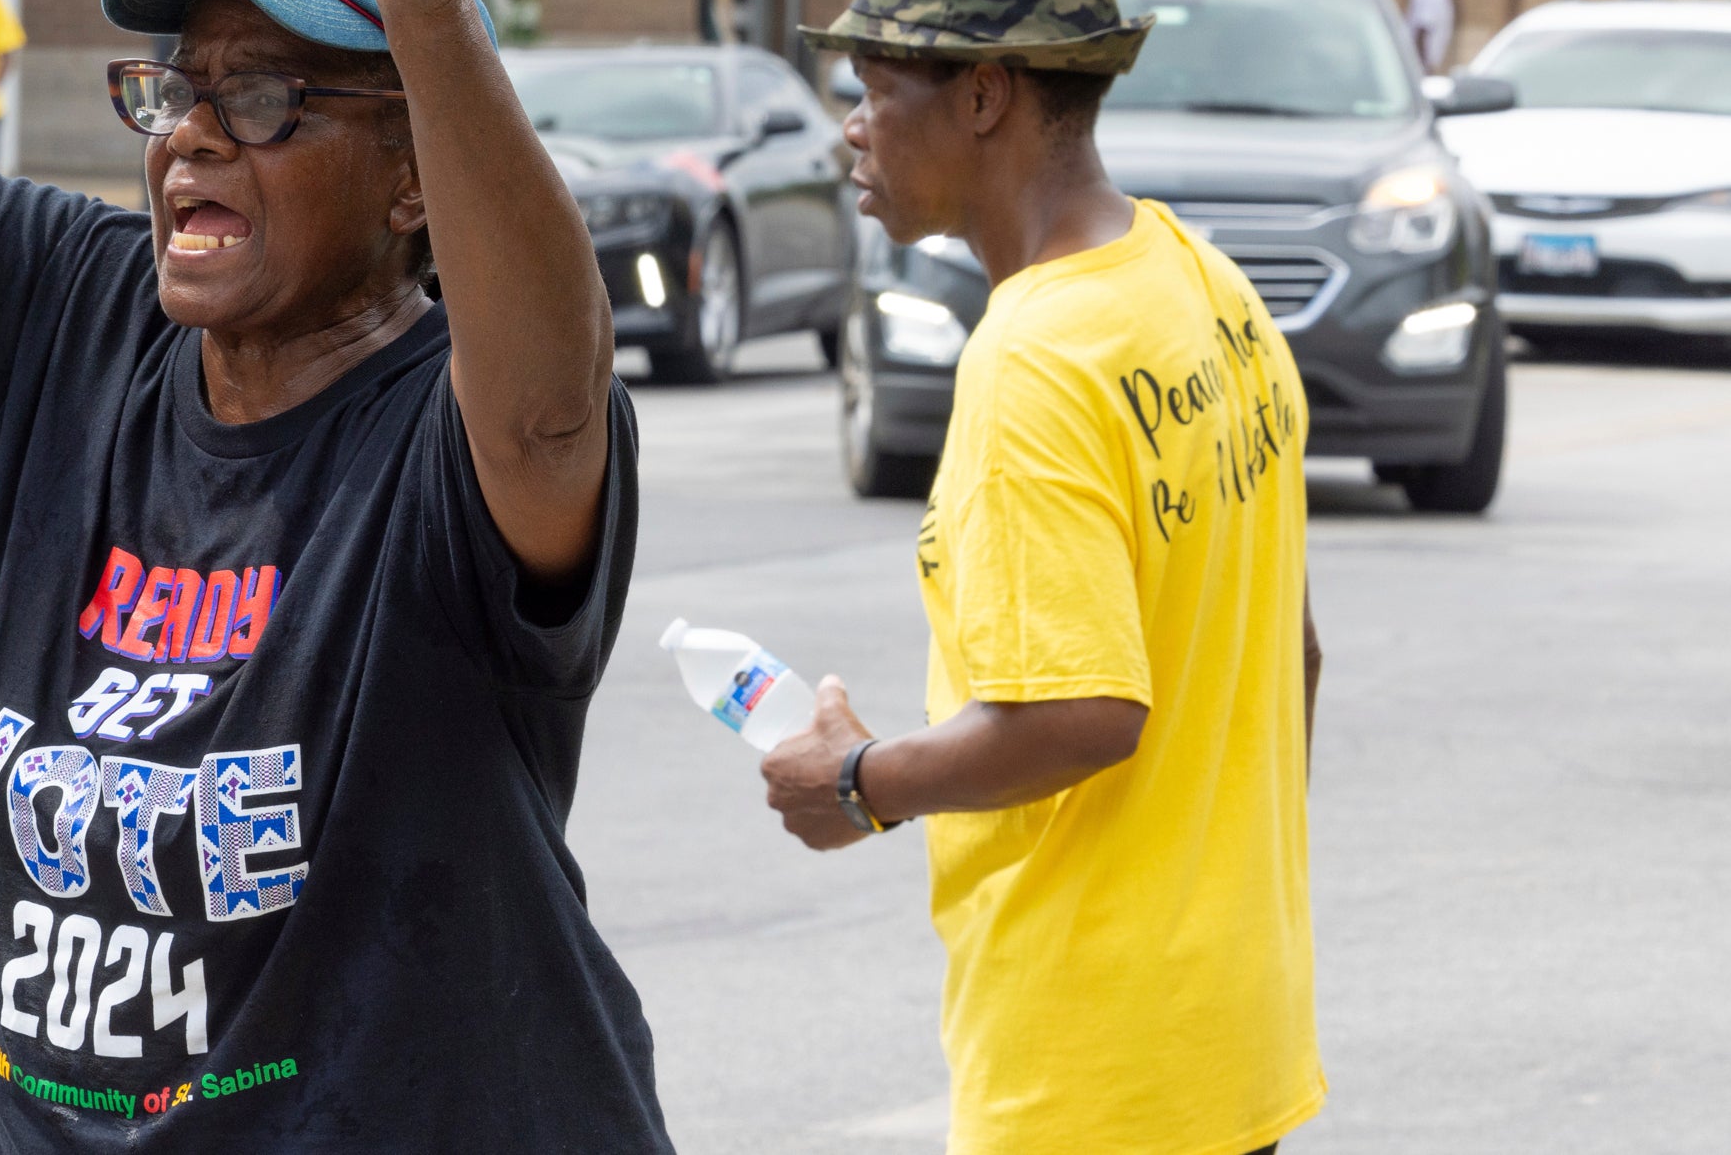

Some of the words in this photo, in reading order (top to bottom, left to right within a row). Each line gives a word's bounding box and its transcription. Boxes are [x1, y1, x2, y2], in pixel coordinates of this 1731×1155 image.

[79, 546, 283, 663] READY
[68, 667, 213, 742] SET
[0, 900, 209, 1058] 2024
[12, 1064, 136, 1120] Community
[144, 1087, 171, 1114] of
[201, 1058, 299, 1100] Sabina
